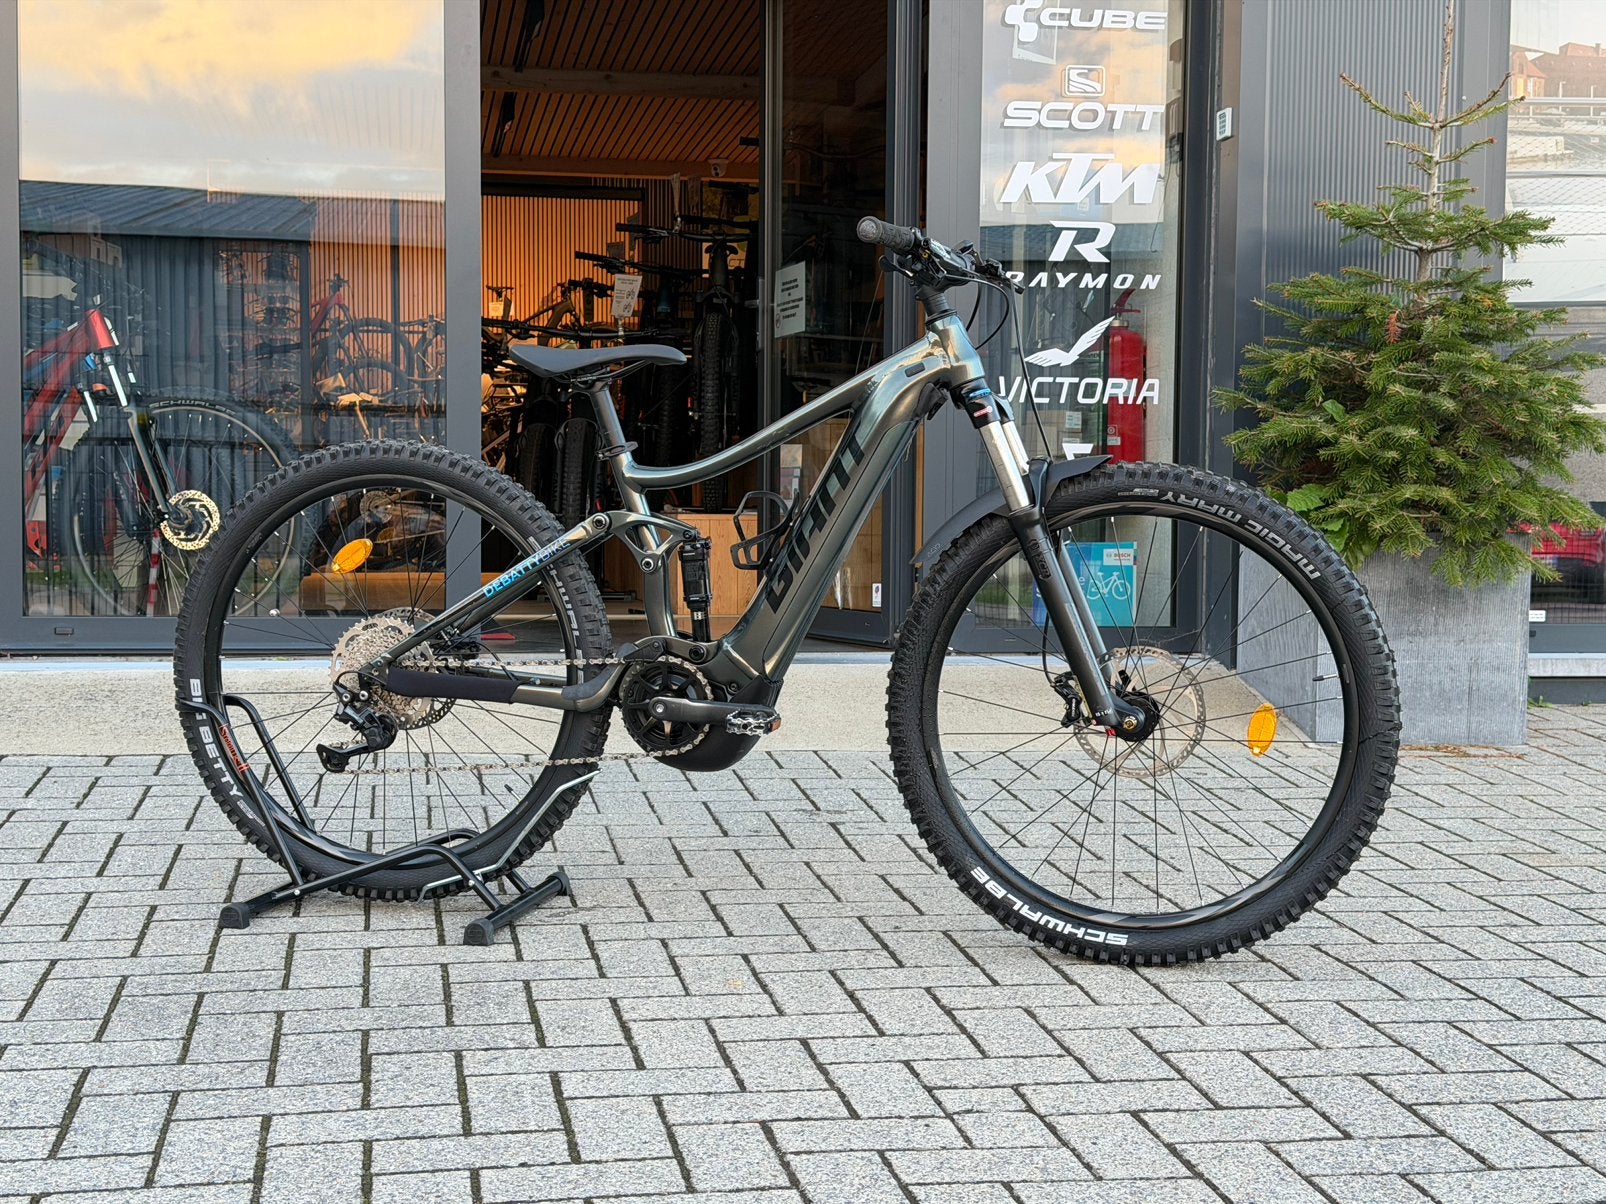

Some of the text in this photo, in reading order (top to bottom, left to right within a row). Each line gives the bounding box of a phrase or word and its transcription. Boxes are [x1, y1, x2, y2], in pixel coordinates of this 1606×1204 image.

[1039, 7, 1168, 30] CUBE
[1004, 101, 1165, 130] SCOTT
[1000, 152, 1161, 204] KTM
[1004, 271, 1162, 290] RAYMON
[998, 375, 1160, 405] VICTORIA
[1160, 491, 1321, 580] MAGIC MARY
[199, 726, 244, 797] BETTY
[970, 866, 1129, 946] SCHWALBE
